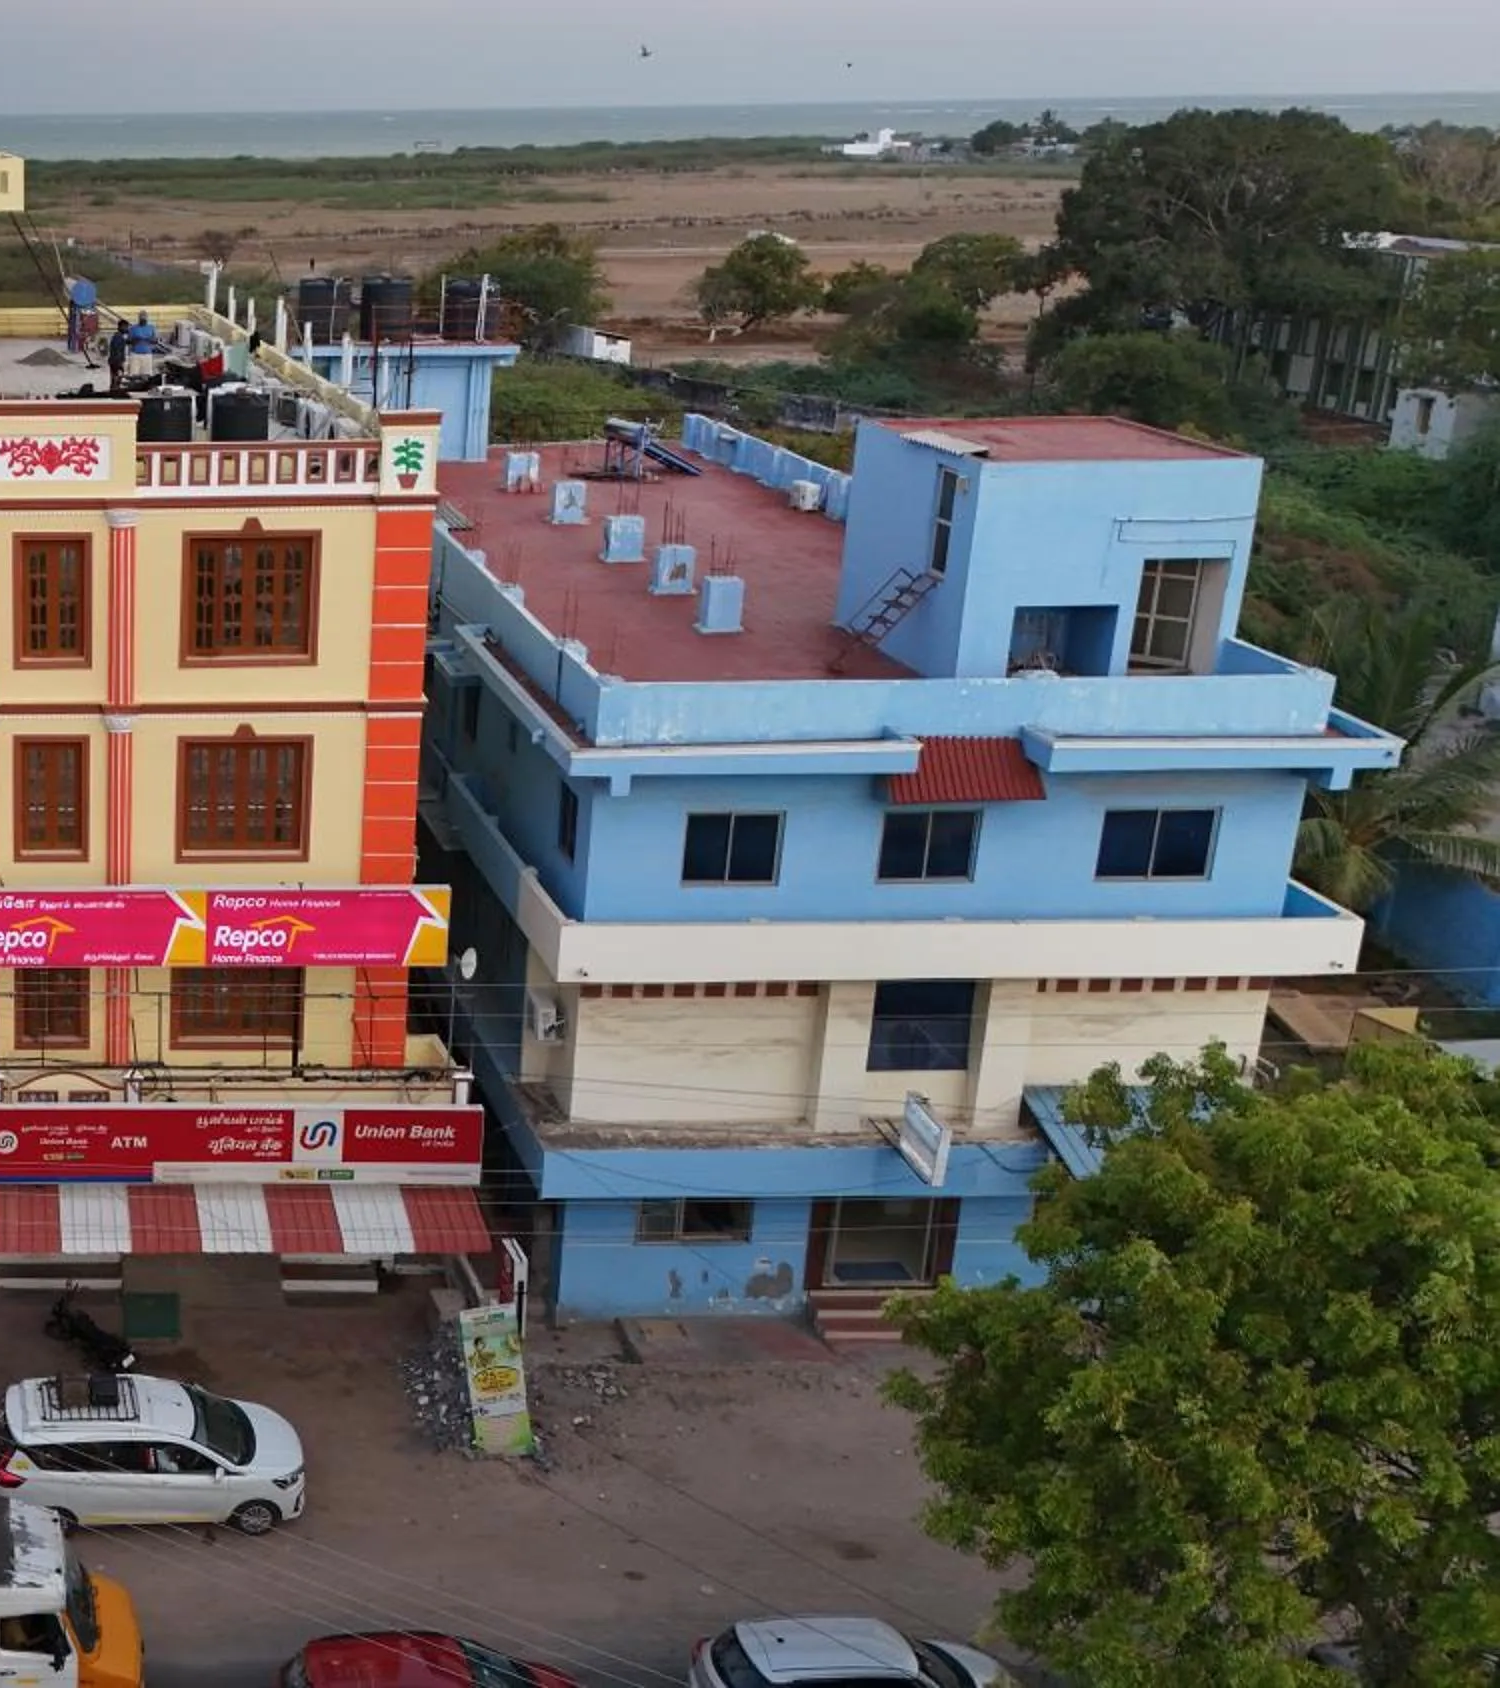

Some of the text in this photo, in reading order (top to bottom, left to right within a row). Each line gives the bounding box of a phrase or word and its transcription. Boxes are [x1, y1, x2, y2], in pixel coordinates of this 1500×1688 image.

[213, 893, 267, 910] Repco
[214, 925, 287, 952] Repco
[6, 954, 45, 965] Finance
[211, 953, 283, 964] Home Finance
[355, 1125, 455, 1138] Union Bank
[111, 1136, 148, 1149] ATM
